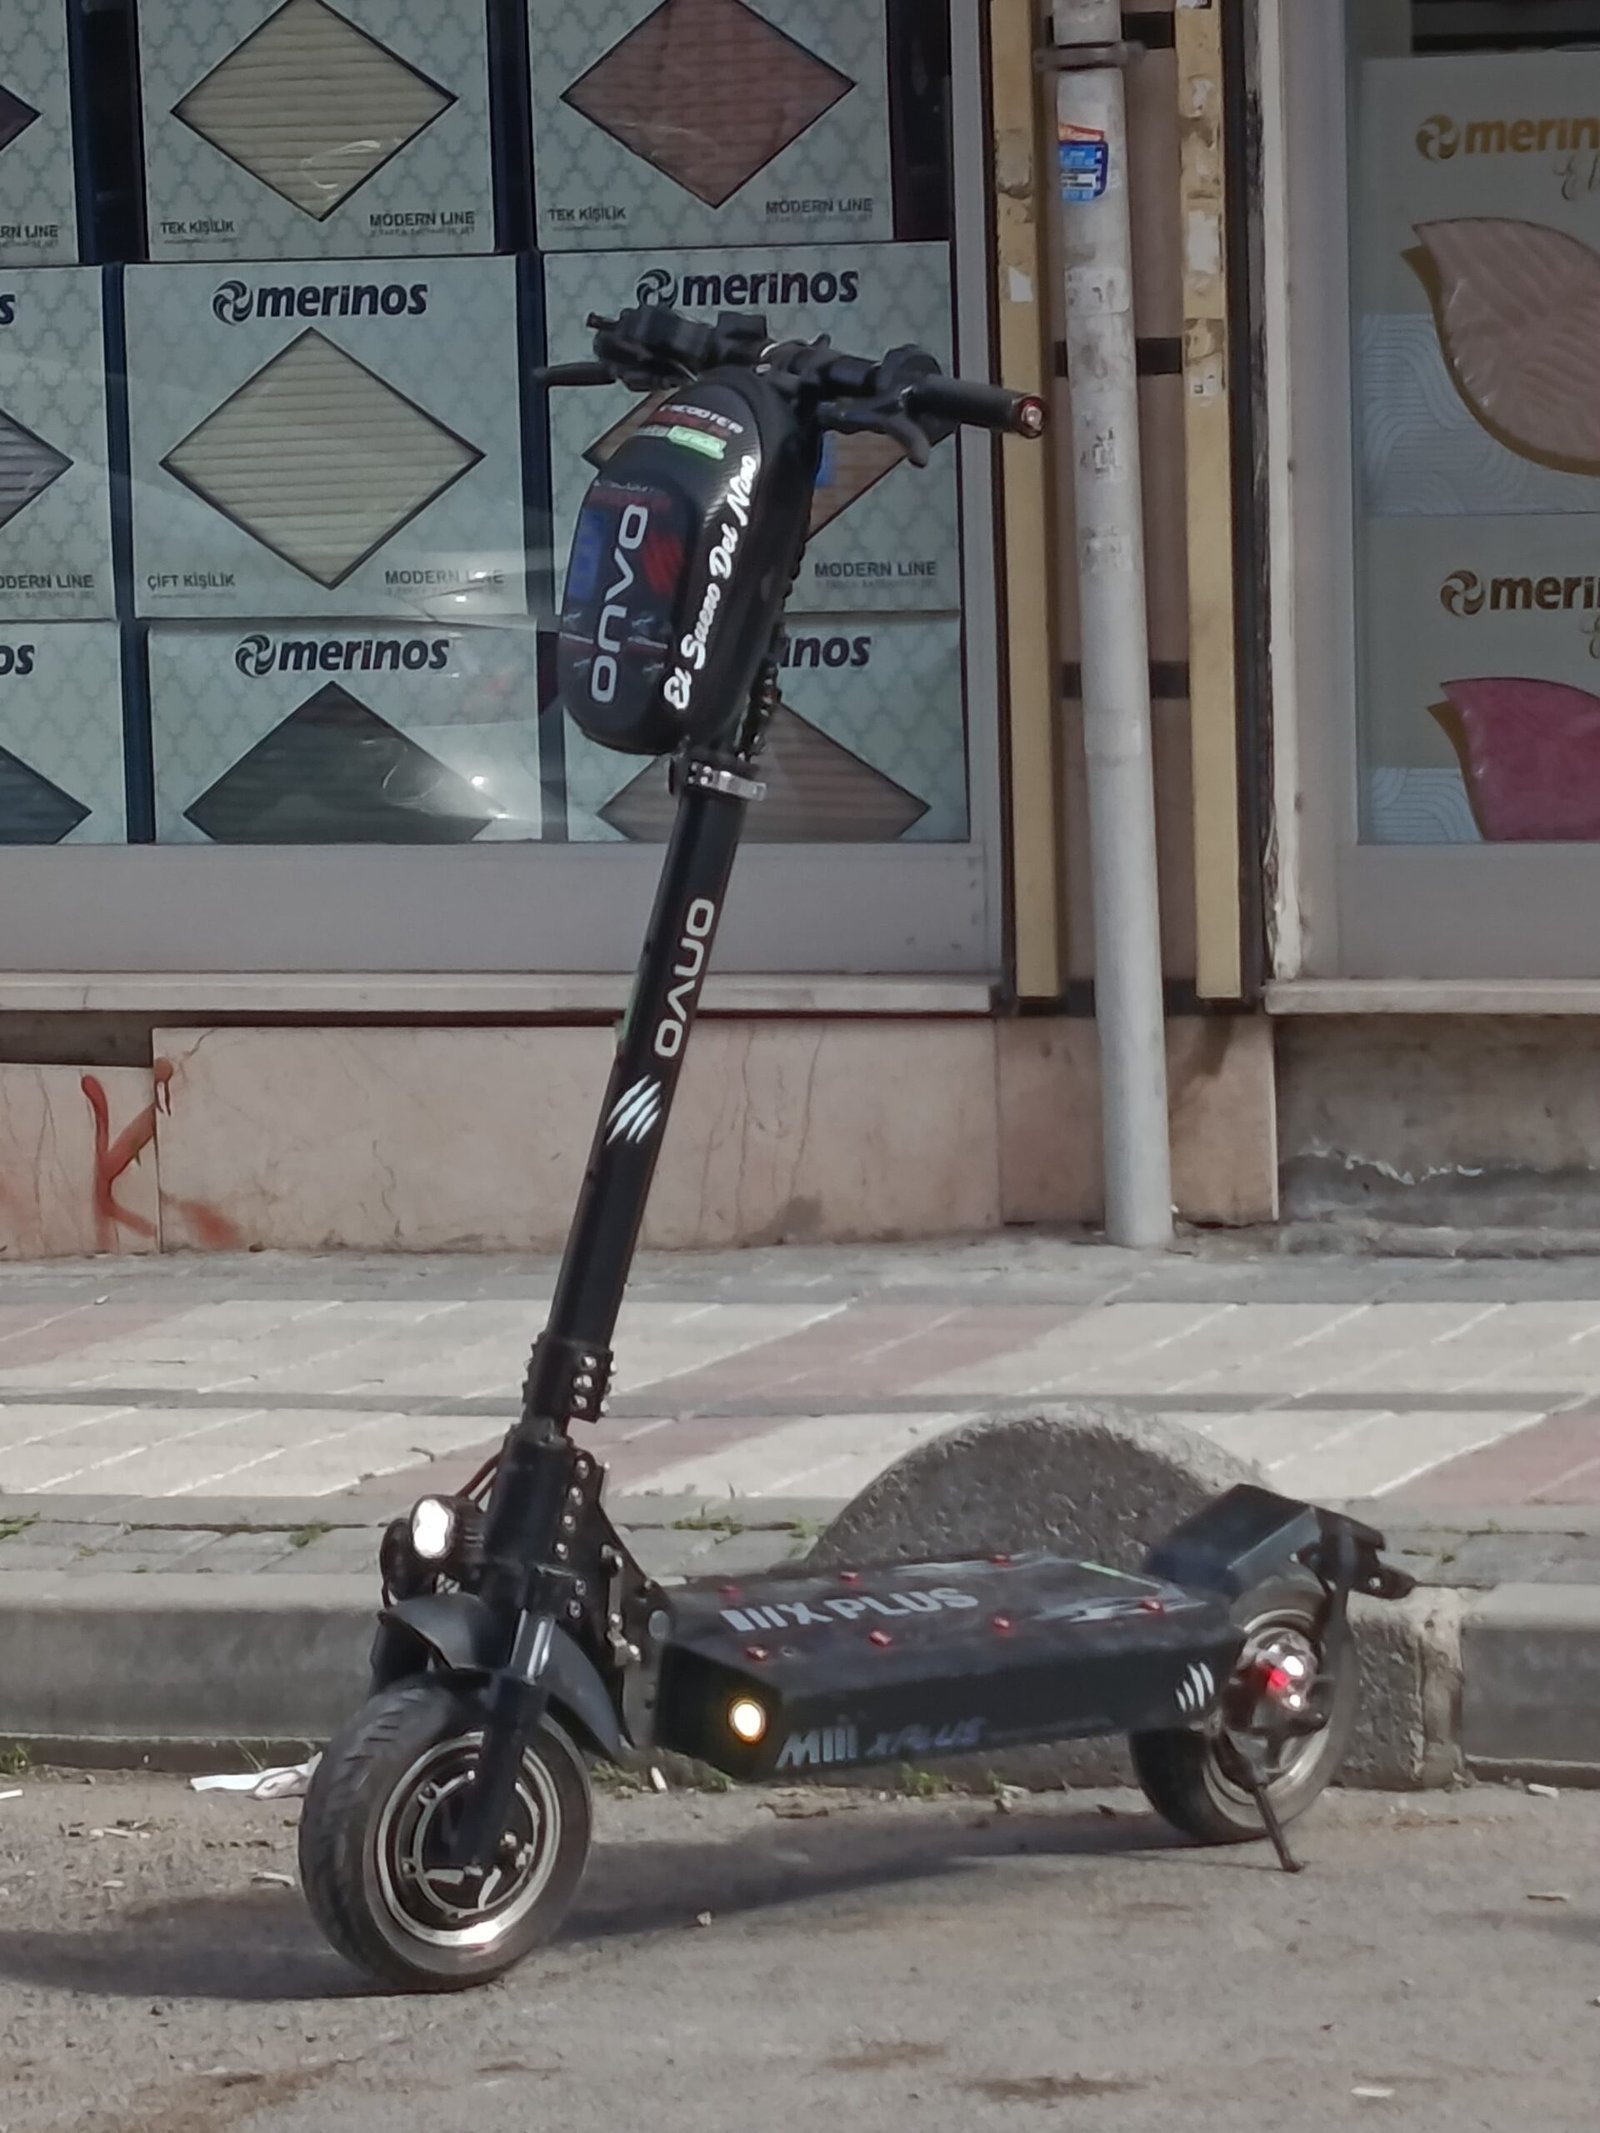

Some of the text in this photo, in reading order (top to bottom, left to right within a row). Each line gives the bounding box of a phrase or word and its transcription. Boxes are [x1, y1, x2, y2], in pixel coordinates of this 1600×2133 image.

[766, 198, 873, 214] MODERN LINE
[370, 211, 475, 227] MODERN LINE
[549, 209, 575, 222] TEK
[25, 224, 59, 239] LINE
[161, 221, 187, 235] TEK
[682, 271, 859, 307] merinos
[256, 282, 428, 318] merinos
[709, 522, 738, 580] Del
[814, 560, 937, 578] MODERN LINE
[56, 574, 95, 589] LINE
[1490, 576, 1600, 611] meri
[278, 638, 450, 672] merinos
[825, 1586, 979, 1620] PLUS
